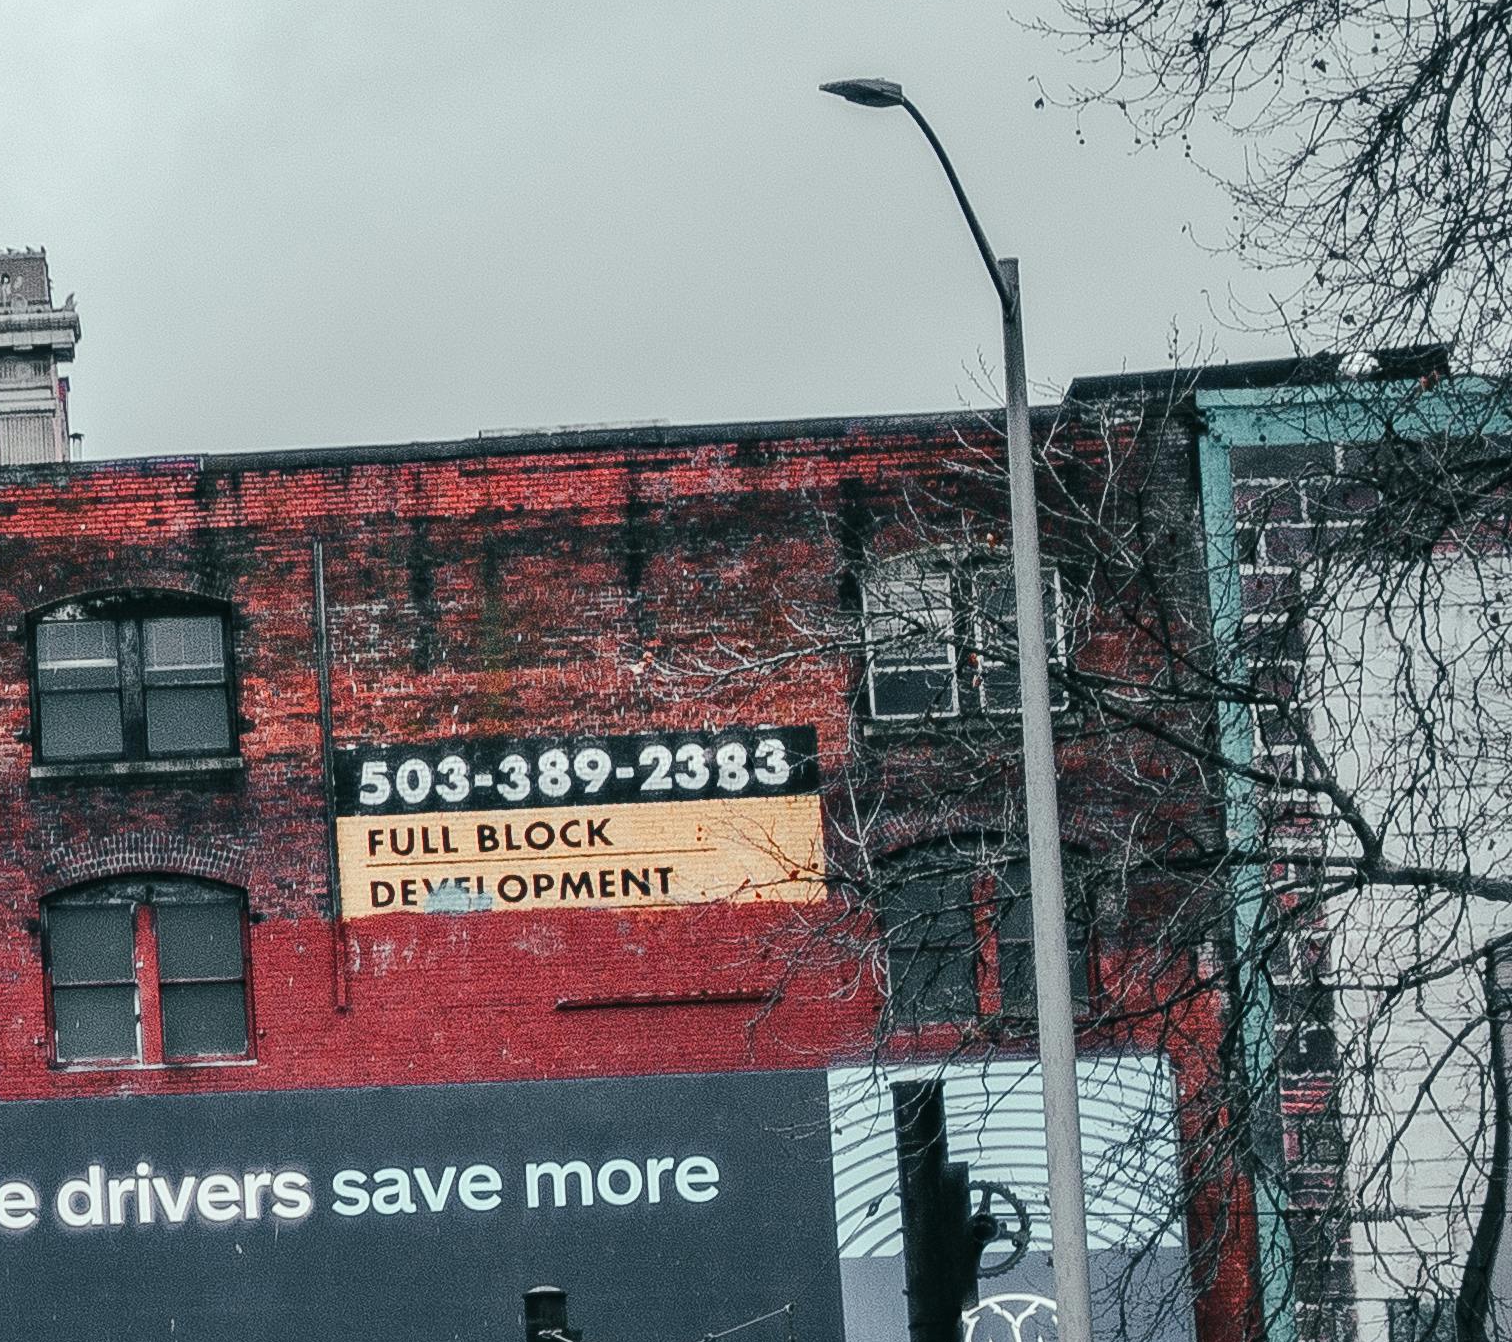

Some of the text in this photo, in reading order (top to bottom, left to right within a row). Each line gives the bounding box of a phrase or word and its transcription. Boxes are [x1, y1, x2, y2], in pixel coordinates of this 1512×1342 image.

[359, 739, 791, 805] 503-389-2383
[367, 818, 614, 856] FULL BLOCK
[57, 1162, 312, 1226] drivers
[331, 1164, 503, 1216] save
[525, 1156, 721, 1209] more
